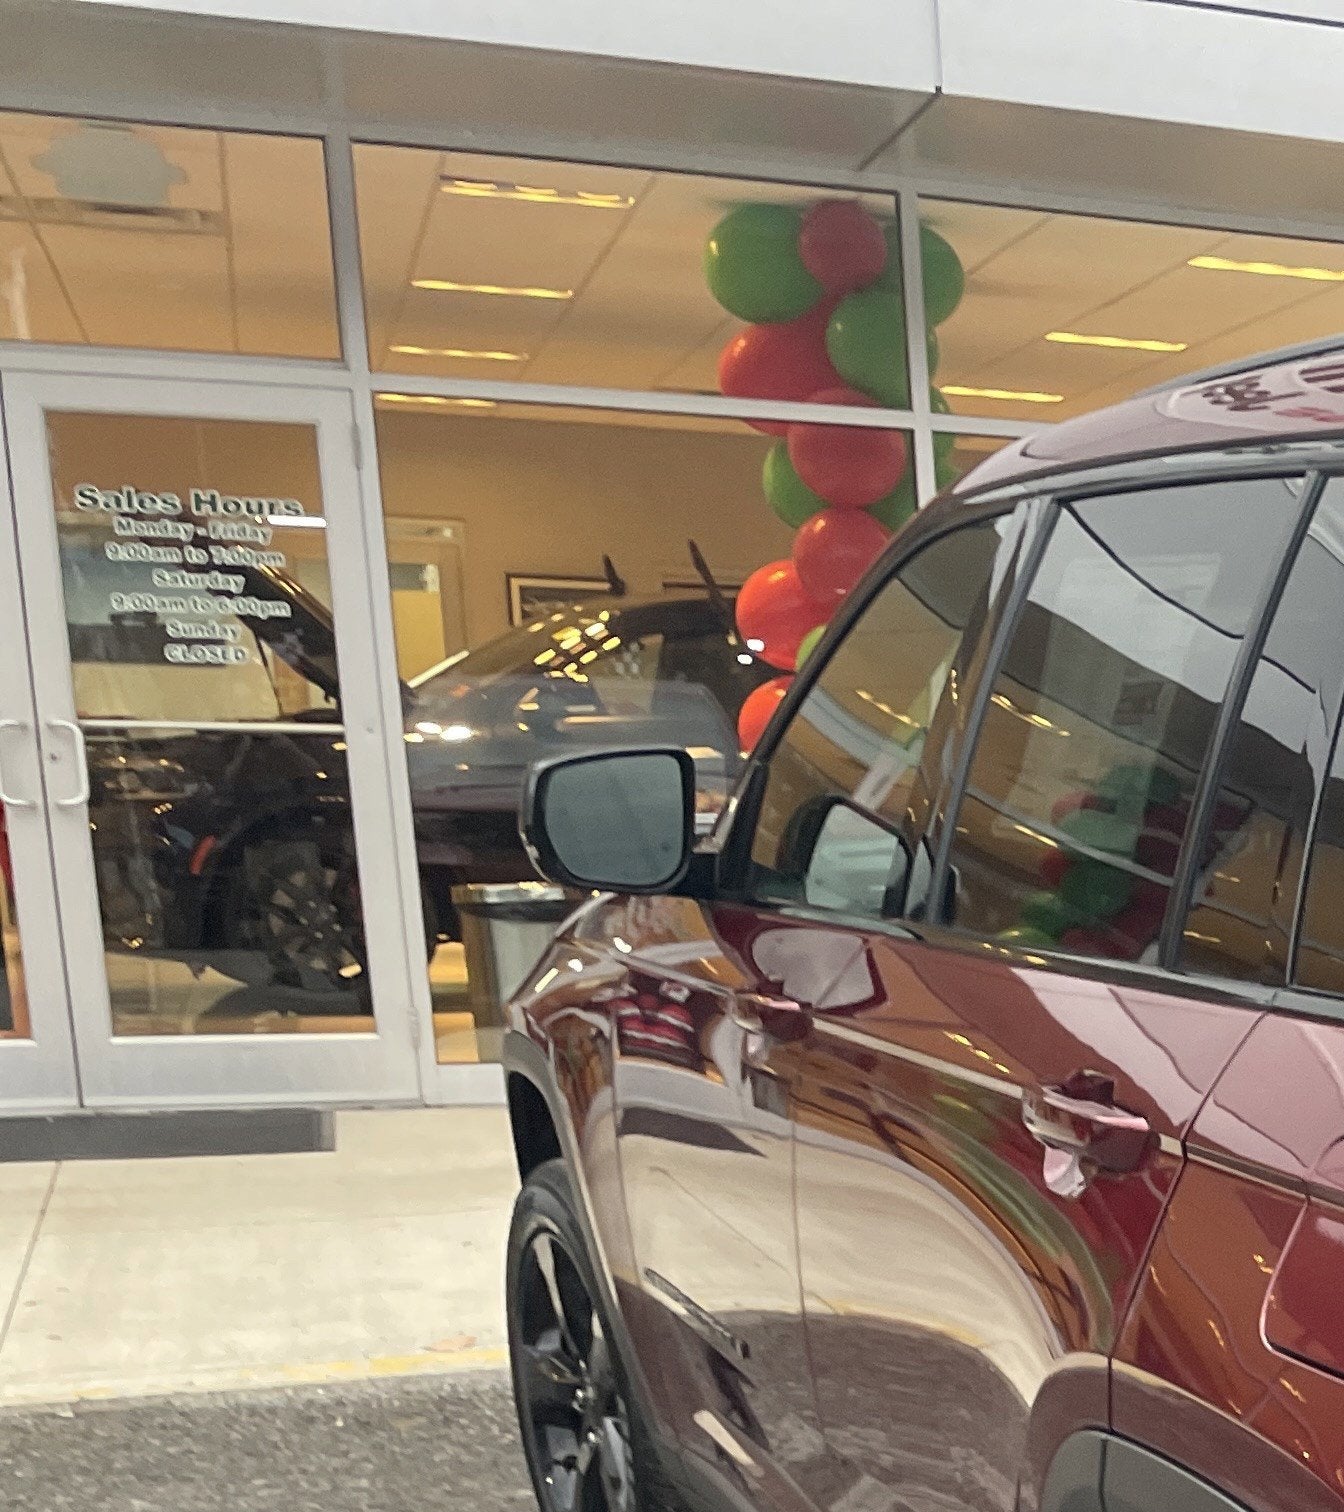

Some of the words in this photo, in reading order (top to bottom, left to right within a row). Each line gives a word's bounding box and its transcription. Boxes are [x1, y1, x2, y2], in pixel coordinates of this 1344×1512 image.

[74, 483, 182, 515] Sales
[190, 488, 304, 517] Hours
[113, 515, 194, 542] Monday
[208, 520, 273, 546] Friday
[184, 545, 209, 564] to
[152, 568, 246, 594] Saturday
[189, 595, 213, 614] to
[166, 618, 241, 642] Sunday
[164, 643, 248, 665] CLOSED
